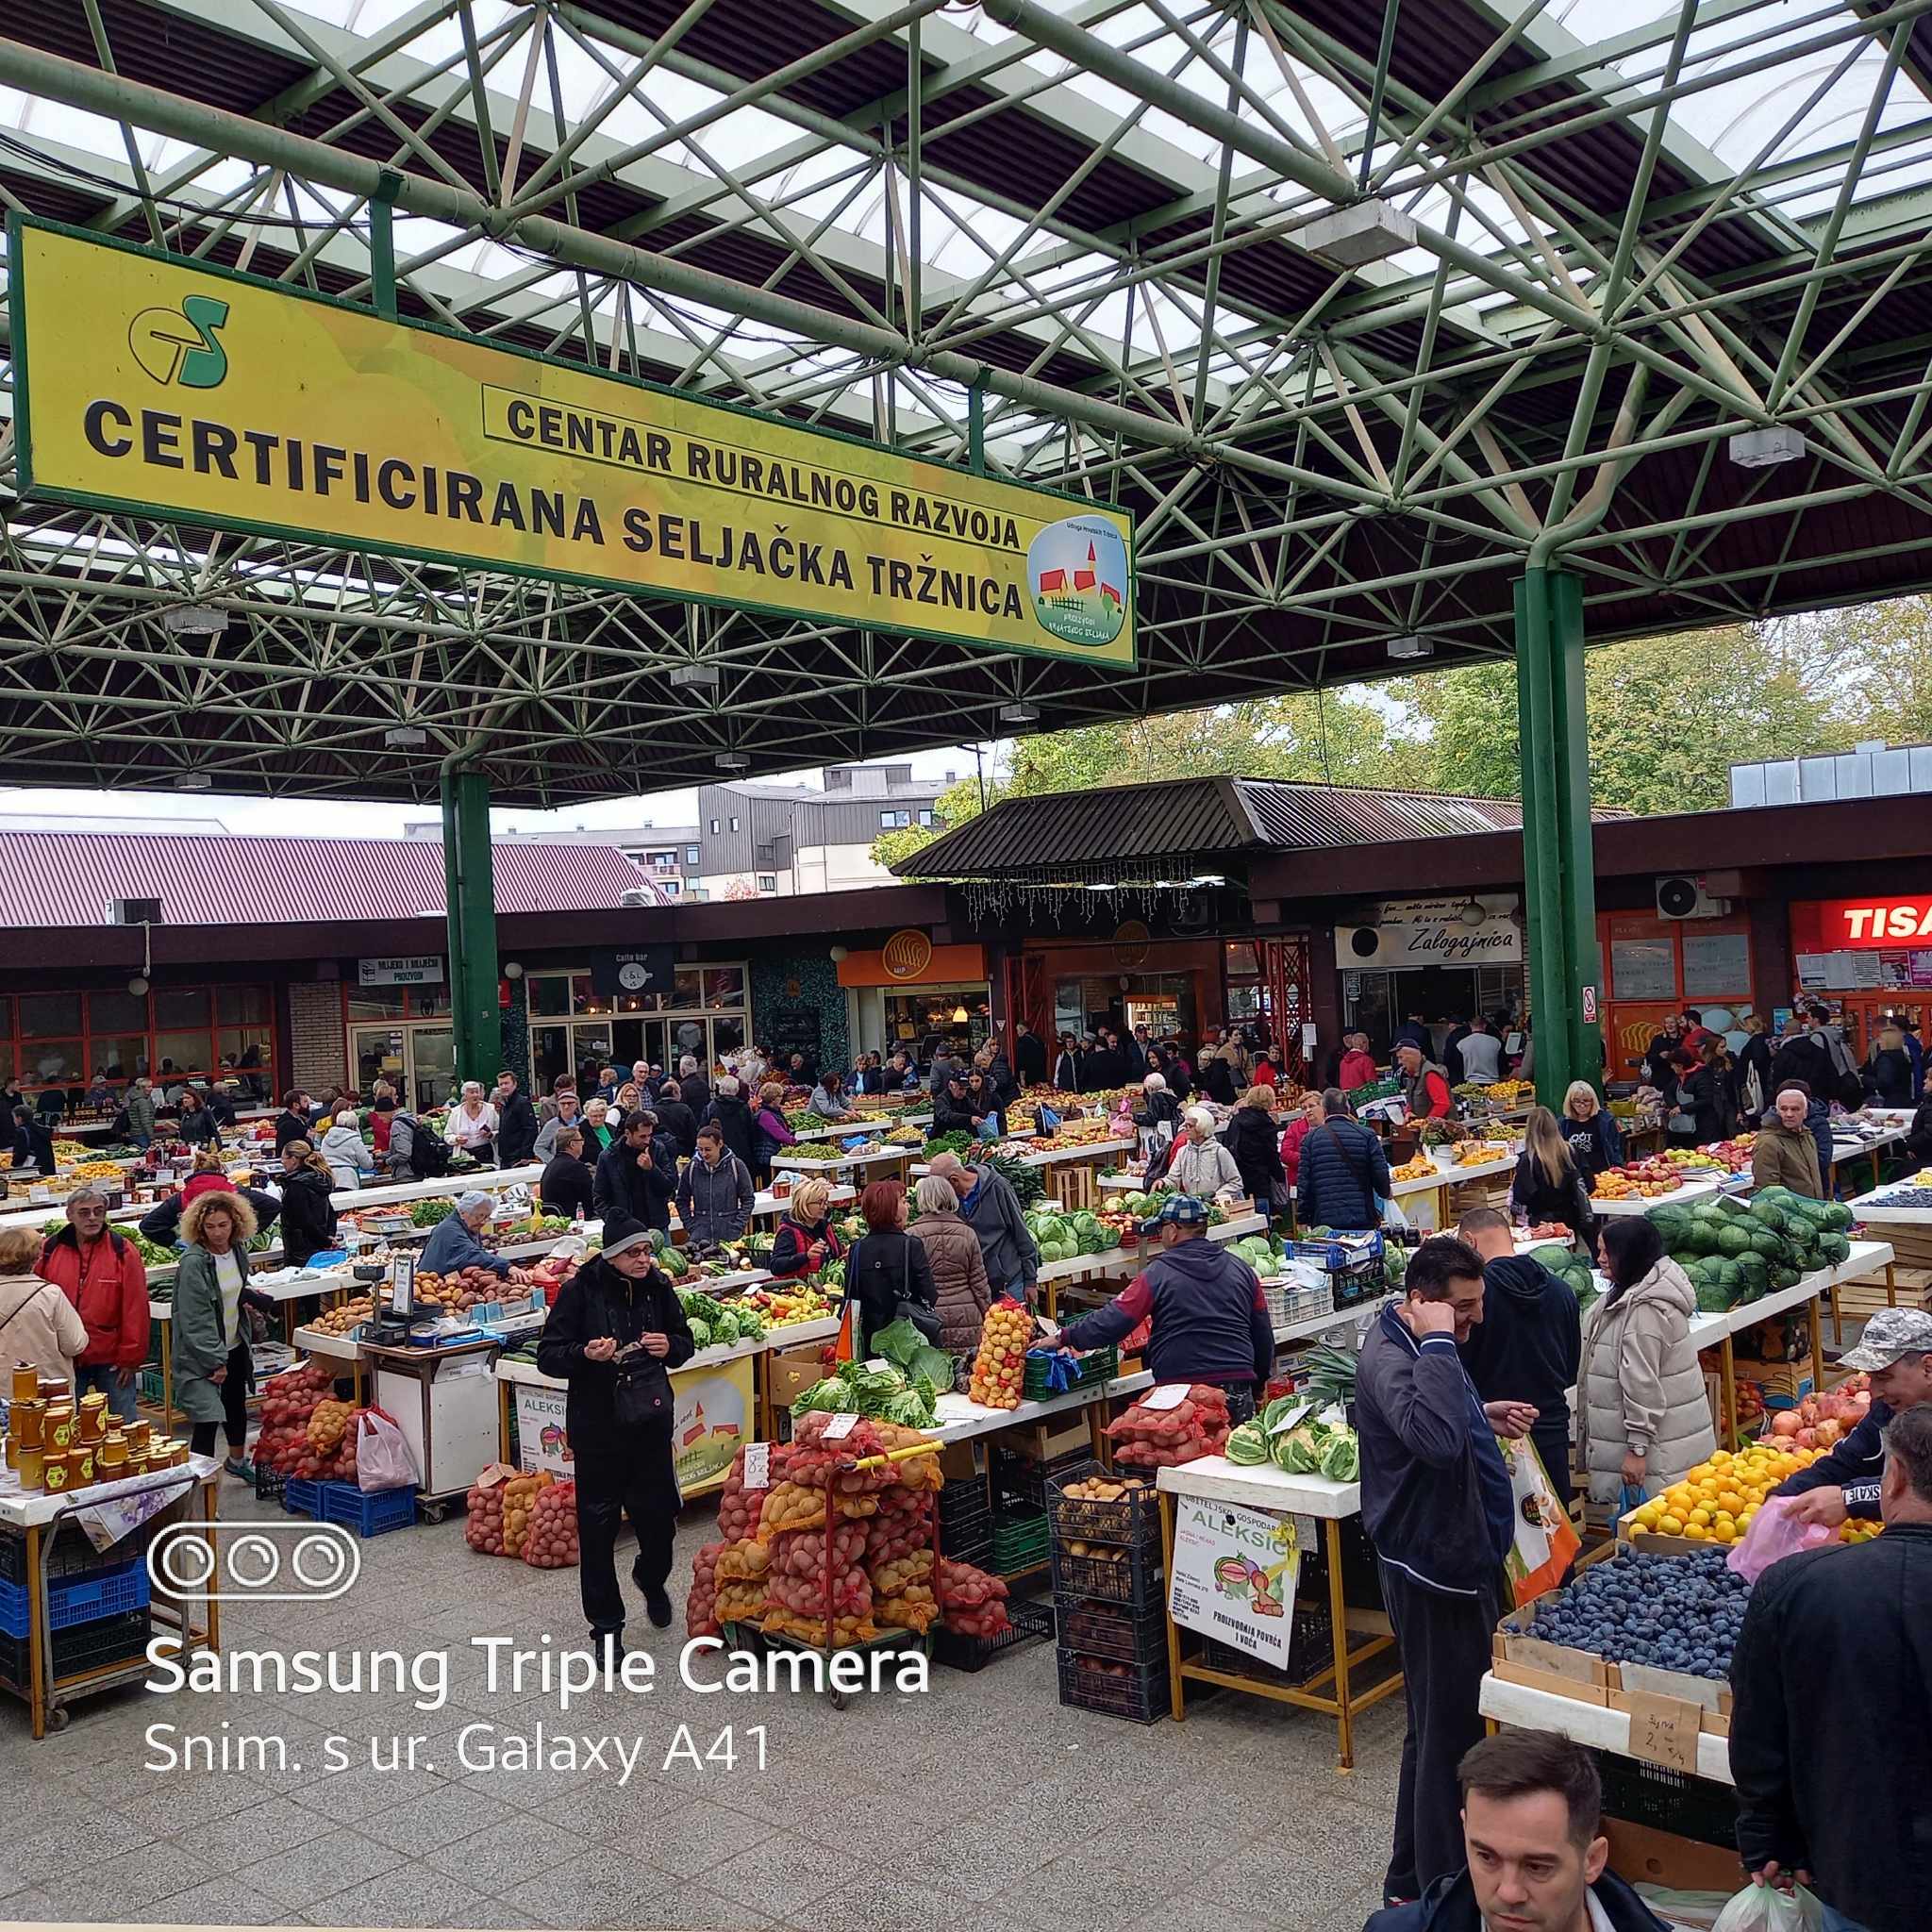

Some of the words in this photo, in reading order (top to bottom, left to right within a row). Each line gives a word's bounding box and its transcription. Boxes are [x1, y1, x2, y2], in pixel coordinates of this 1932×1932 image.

[83, 399, 605, 545] CERTIFICIRANA
[622, 507, 854, 591] SELJAČKA
[867, 552, 1024, 619] TRŽNICA
[507, 399, 672, 471] CENTAR
[688, 442, 879, 518] RURALNOG
[891, 491, 1021, 549] RAZVOJA
[1408, 928, 1513, 958] Zalogajnica
[1237, 1513, 1279, 1533] GOSPODAR
